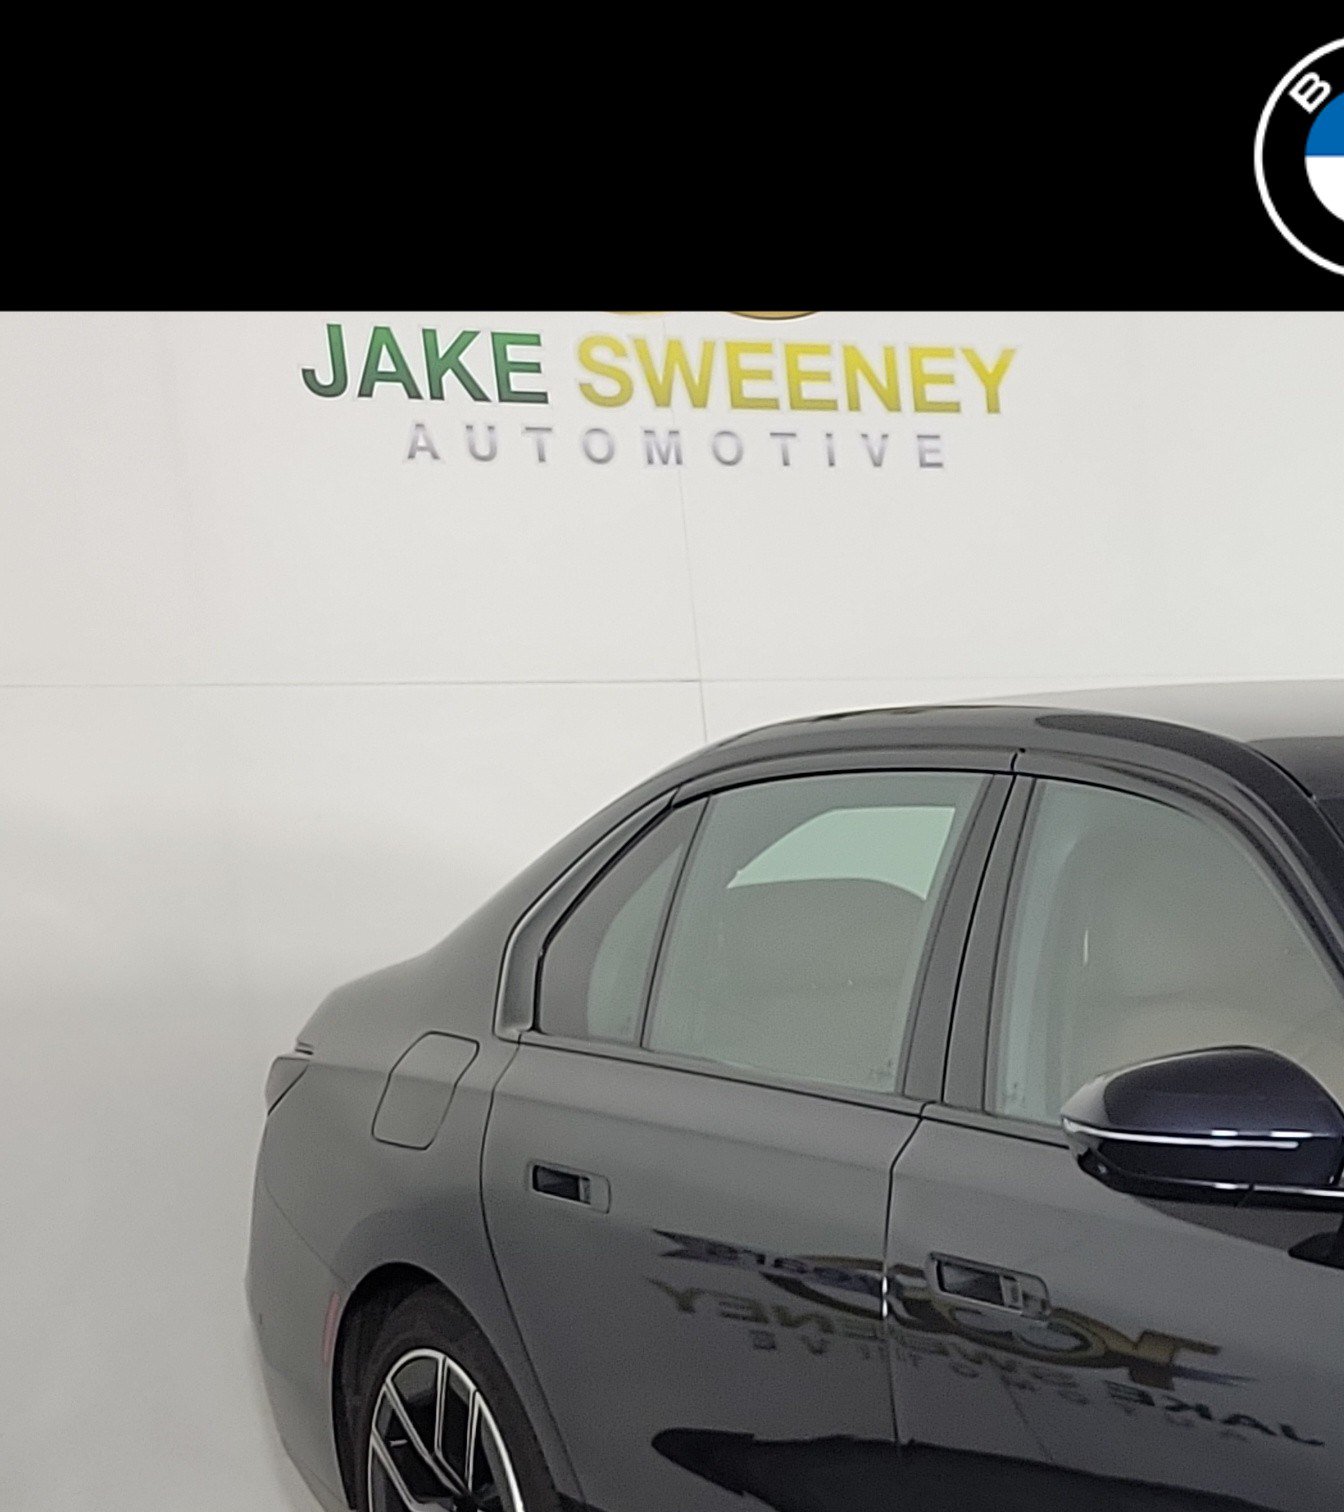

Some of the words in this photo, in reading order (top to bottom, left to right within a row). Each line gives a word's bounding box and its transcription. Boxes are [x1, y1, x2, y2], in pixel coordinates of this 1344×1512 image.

[301, 323, 550, 404] JAKE
[577, 332, 1017, 414] SWEENEY
[407, 422, 944, 469] AUTOMOTIVE
